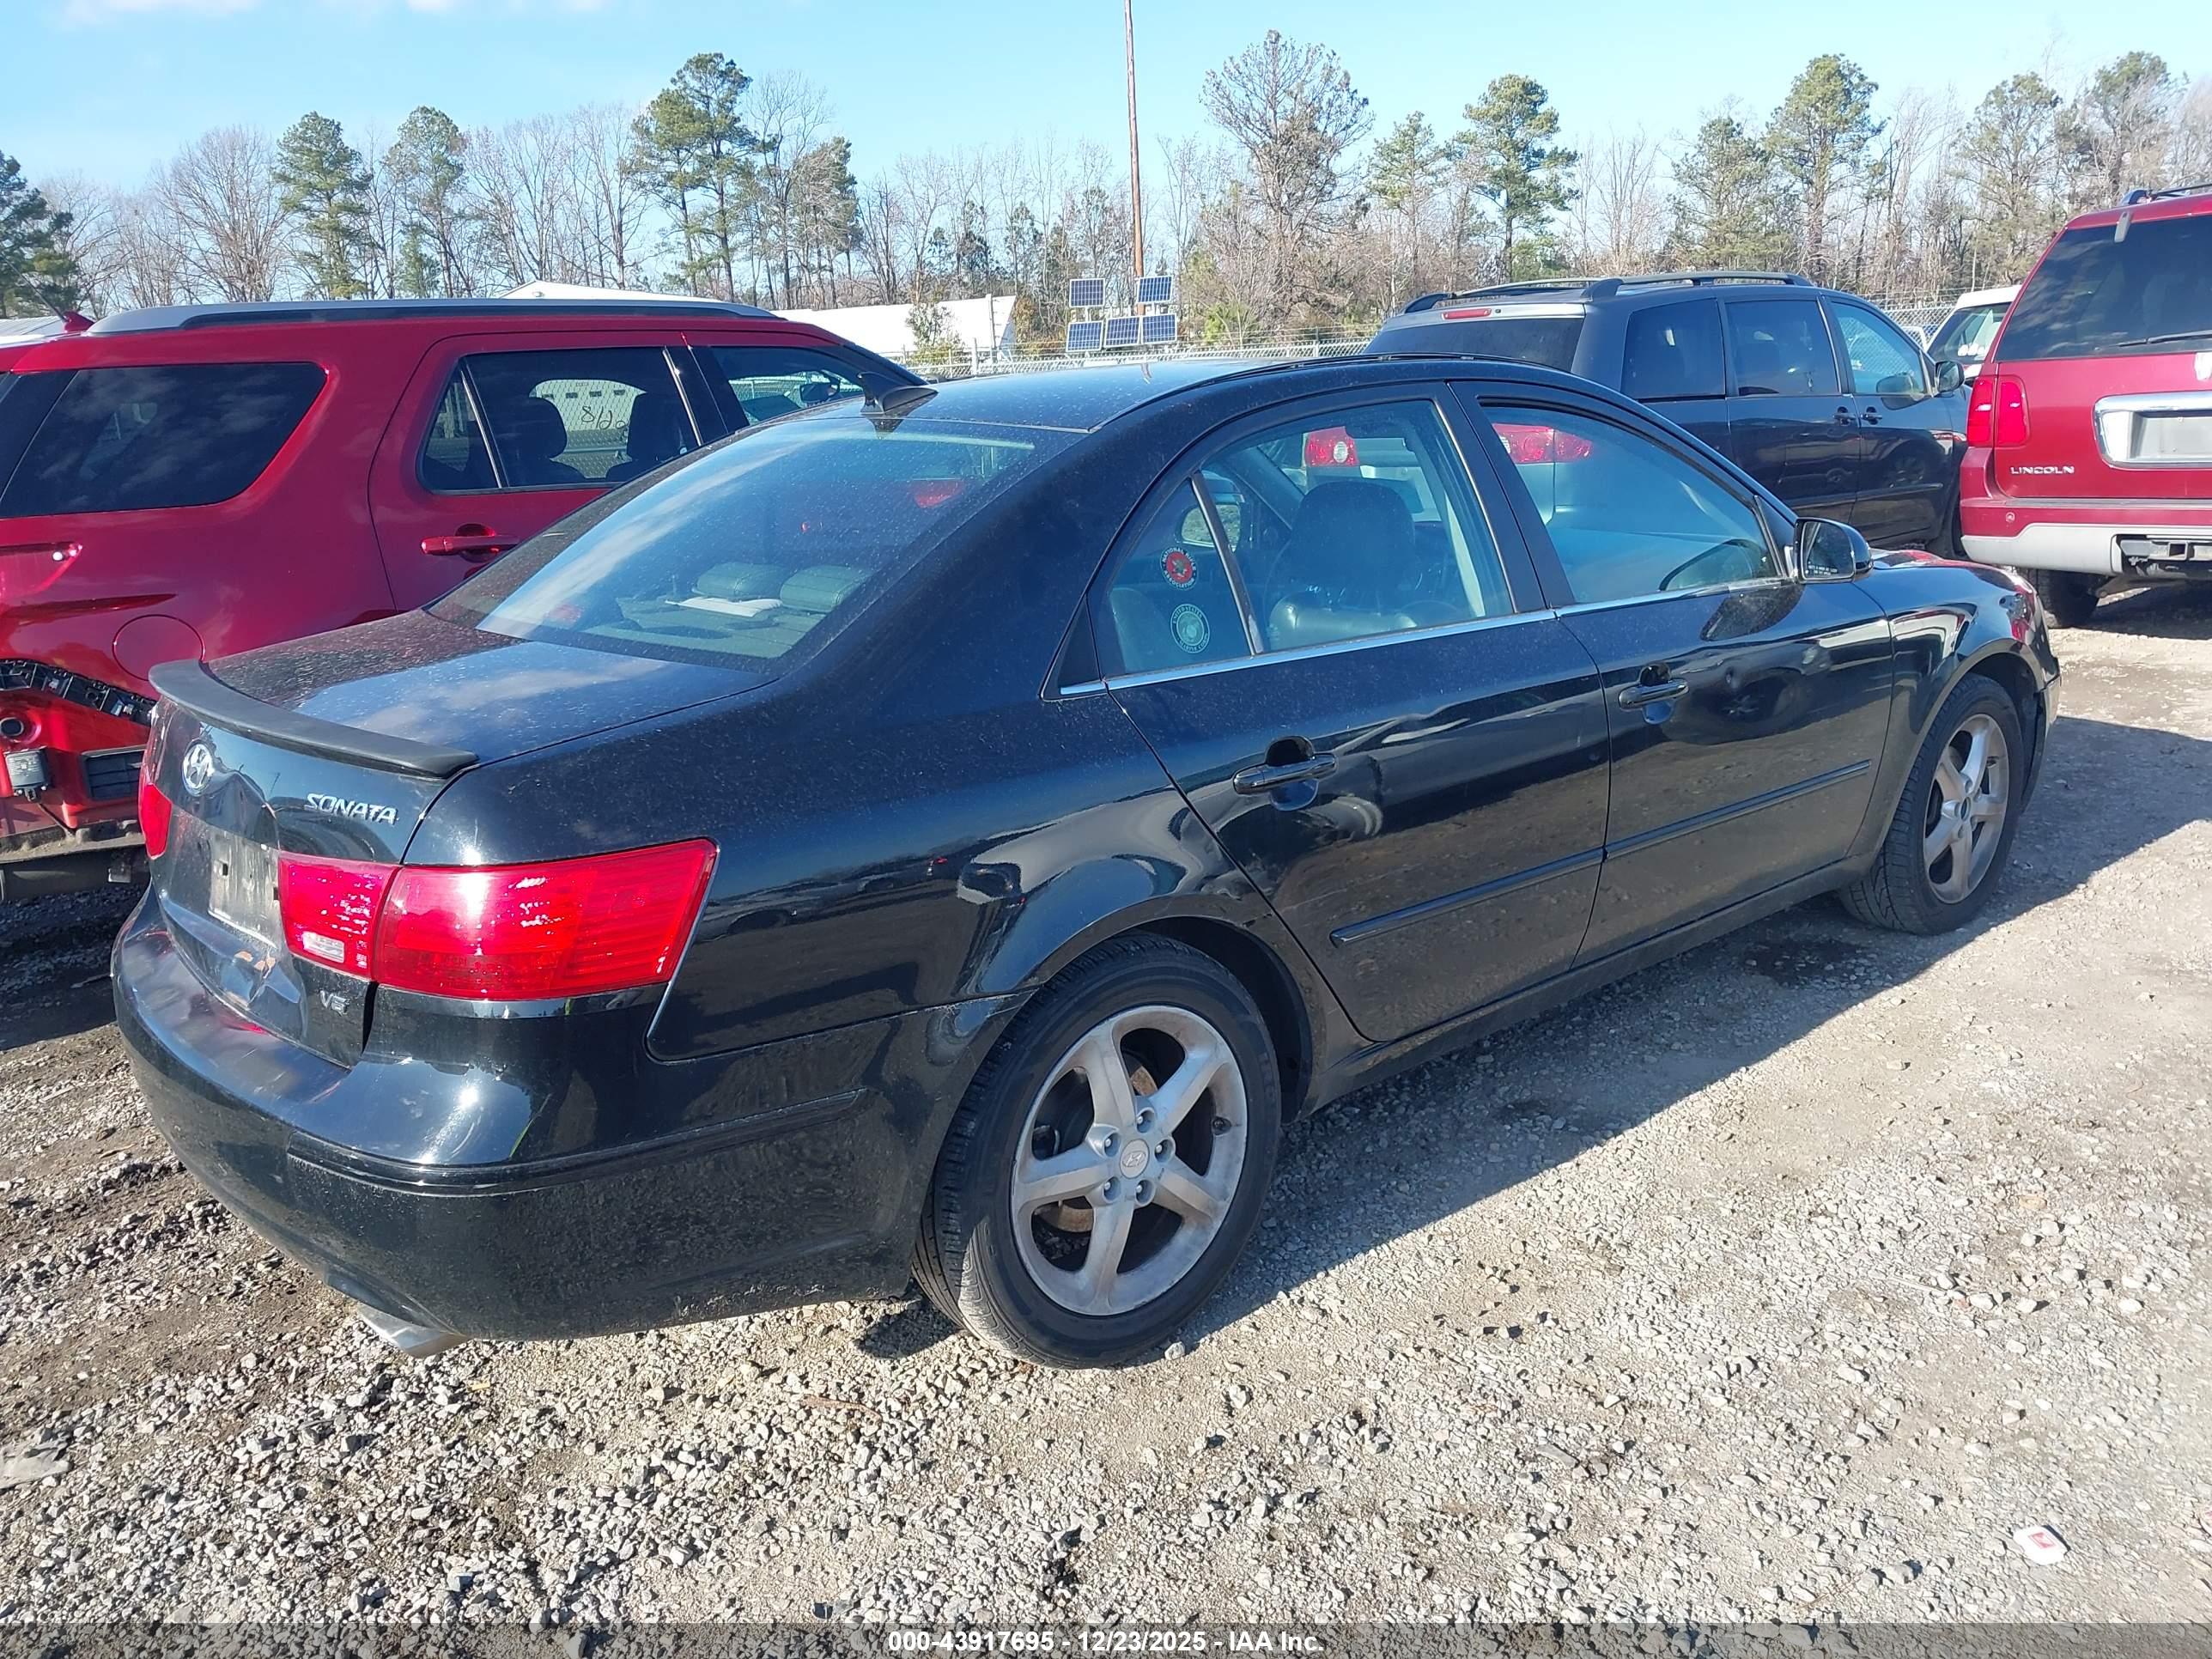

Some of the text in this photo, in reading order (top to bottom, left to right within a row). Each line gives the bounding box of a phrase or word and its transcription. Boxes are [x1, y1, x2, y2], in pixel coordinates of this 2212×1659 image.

[2009, 465, 2075, 475] LINCOLN
[1162, 546, 1184, 562] NATIONAL
[304, 793, 398, 825] SONATA
[319, 991, 349, 1016] V6
